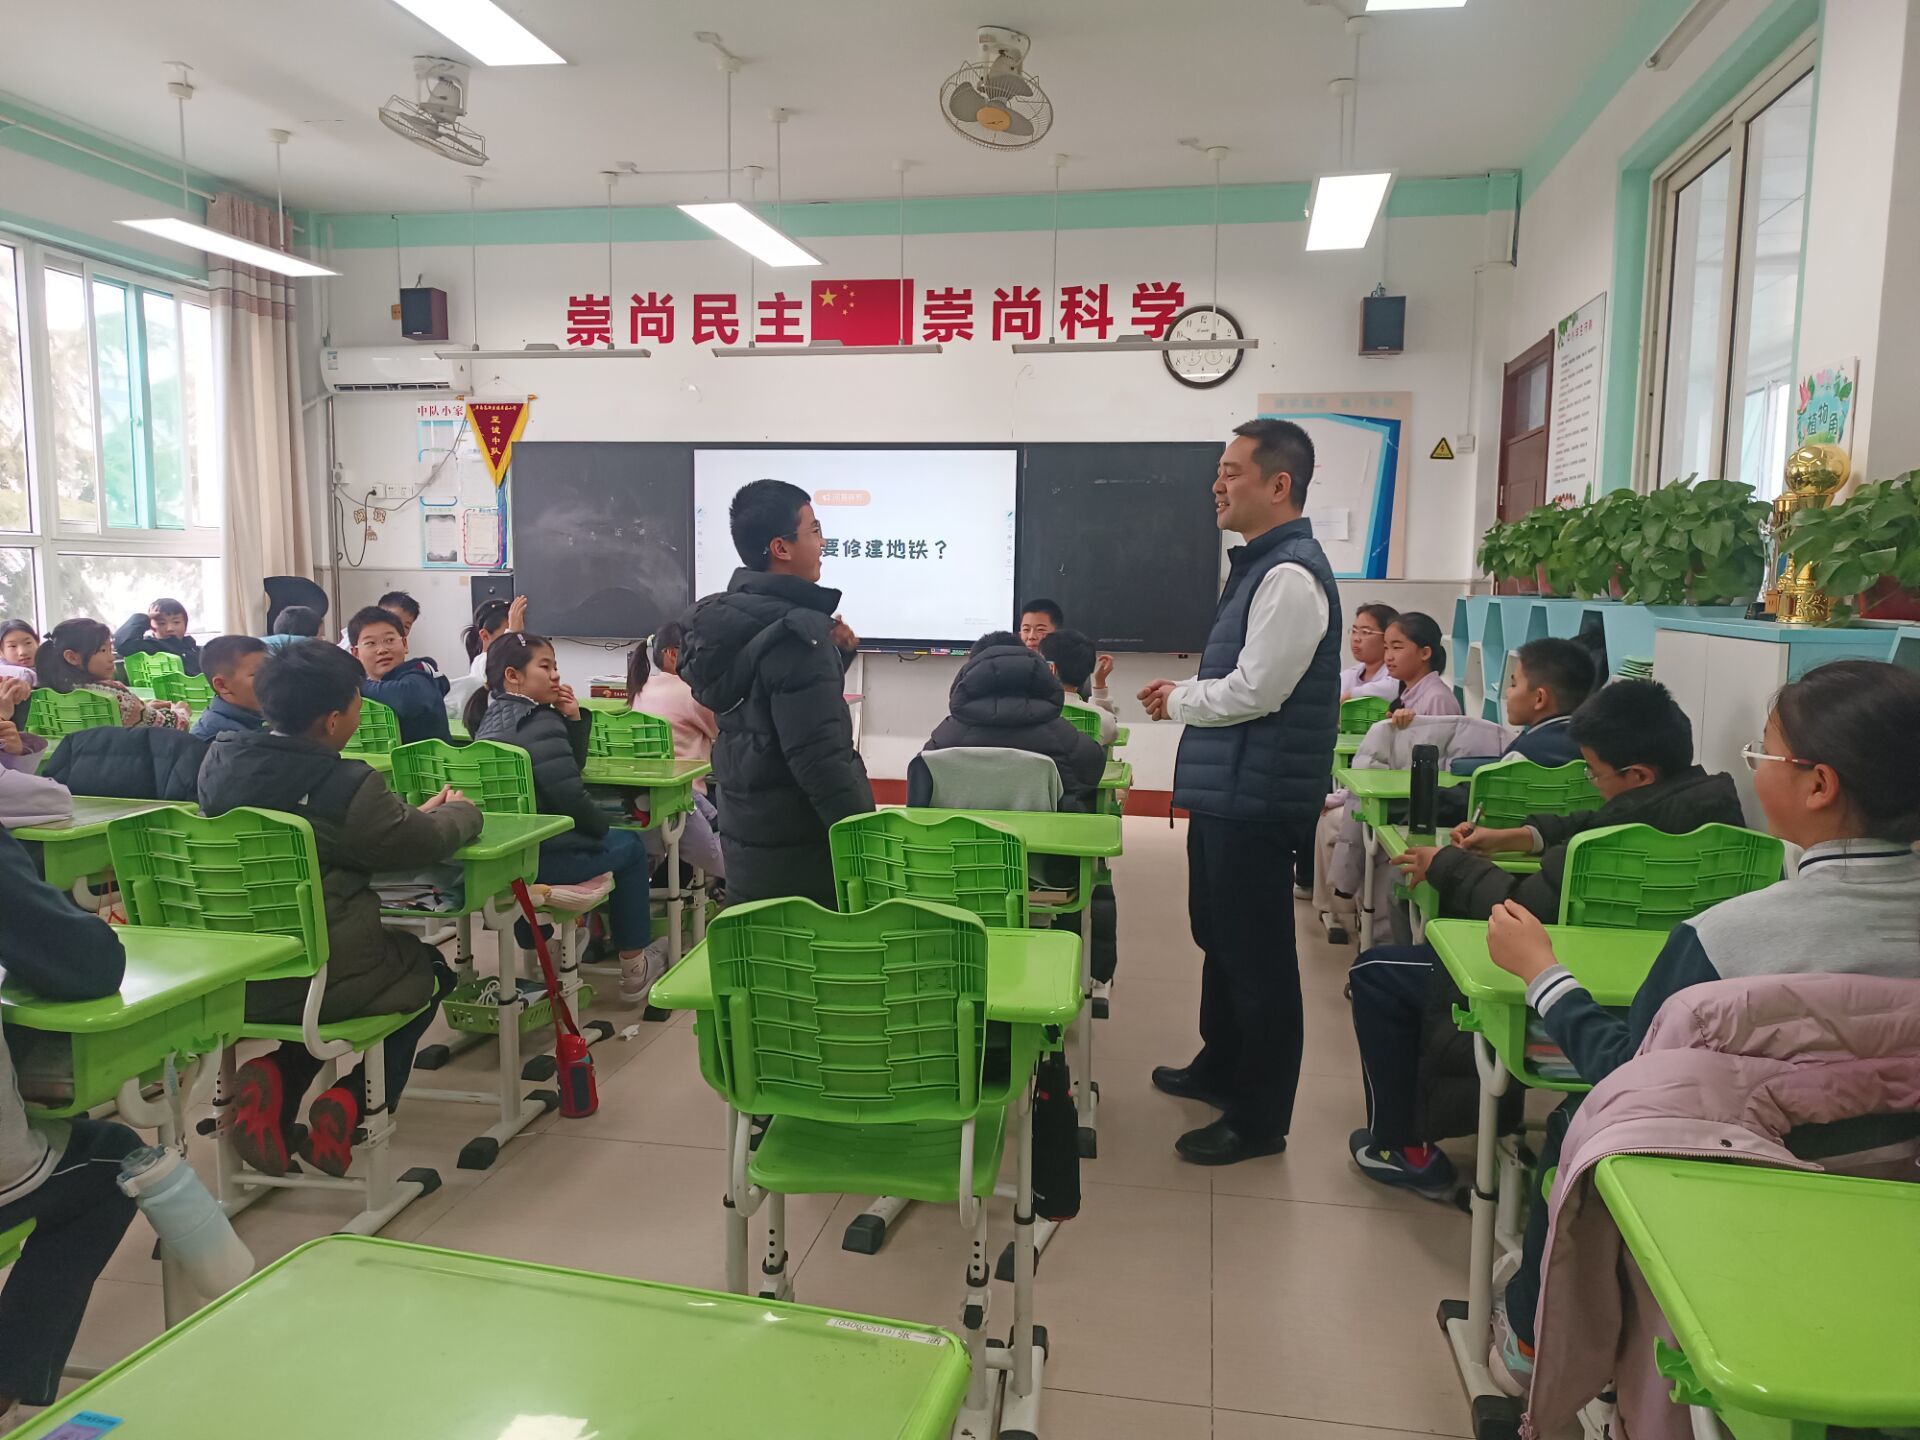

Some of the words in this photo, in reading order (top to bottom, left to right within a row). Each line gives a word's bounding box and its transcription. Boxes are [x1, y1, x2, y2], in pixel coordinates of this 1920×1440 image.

[567, 292, 804, 346] 崇尚民主
[923, 282, 1186, 342] 崇尚科学
[417, 405, 464, 417] 中队小家
[1807, 402, 1838, 435] 植物角
